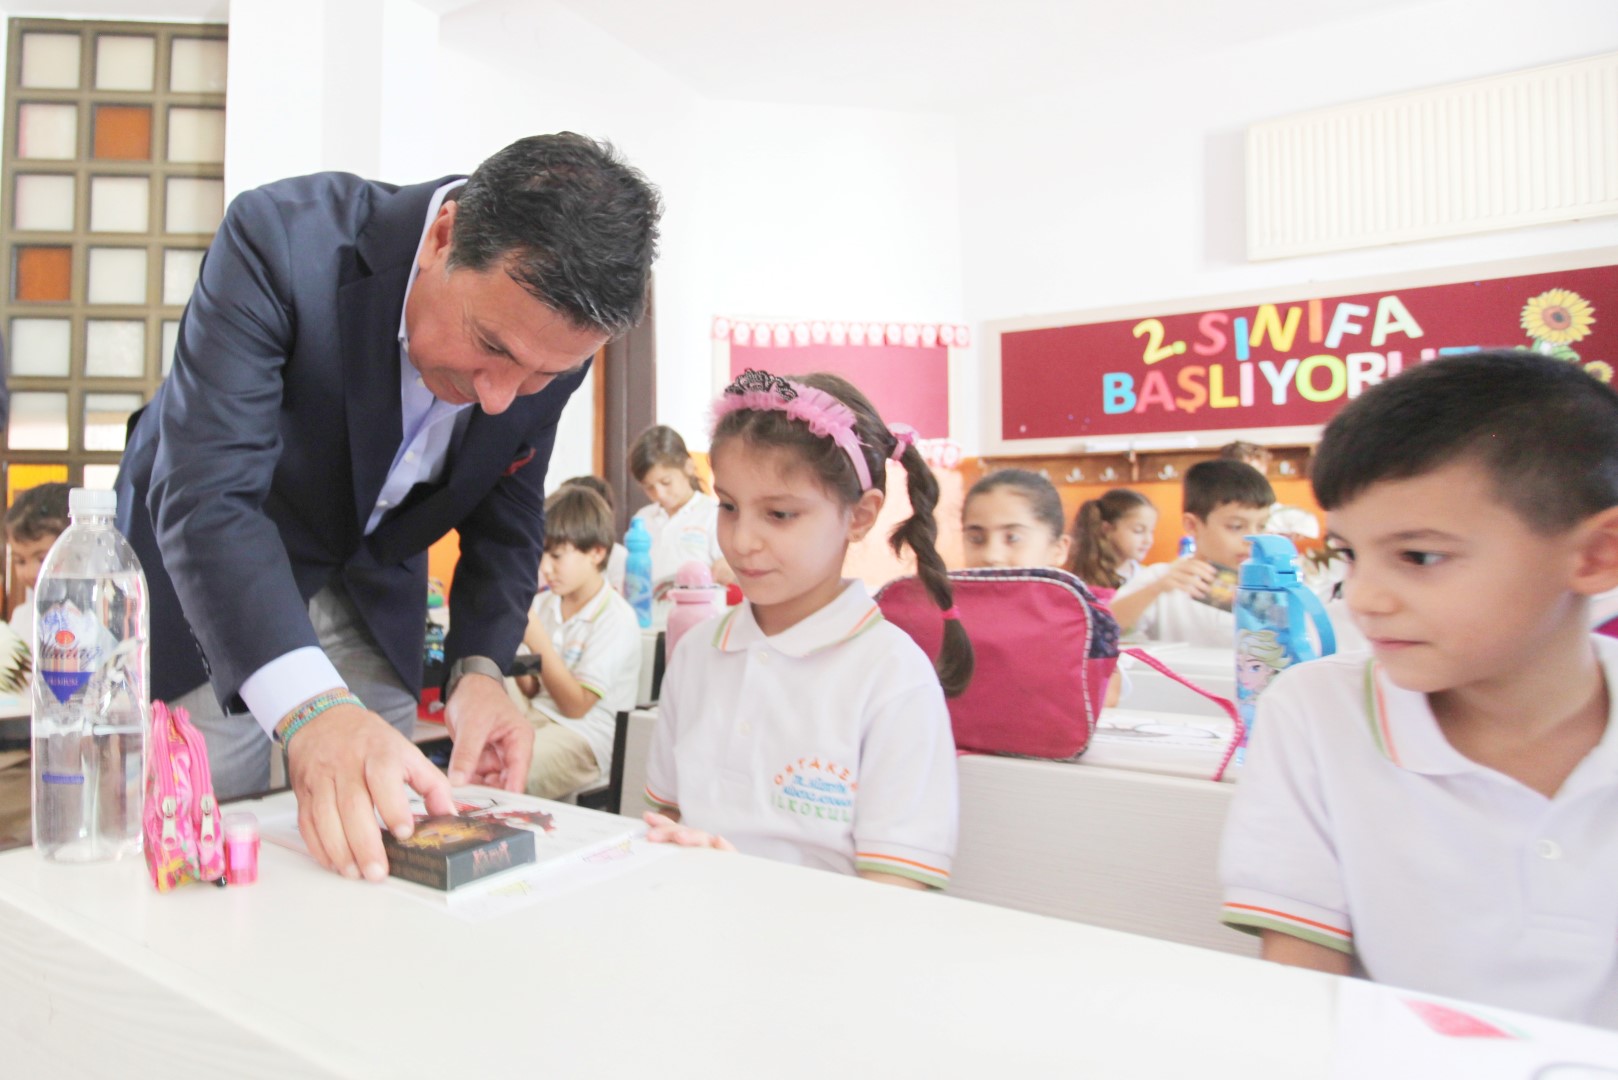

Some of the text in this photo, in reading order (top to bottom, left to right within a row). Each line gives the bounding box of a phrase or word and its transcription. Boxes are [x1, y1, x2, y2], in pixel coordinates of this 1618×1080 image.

[1133, 295, 1424, 365] 2. SINIFA
[1103, 346, 1482, 414] BAŞLIYOR
